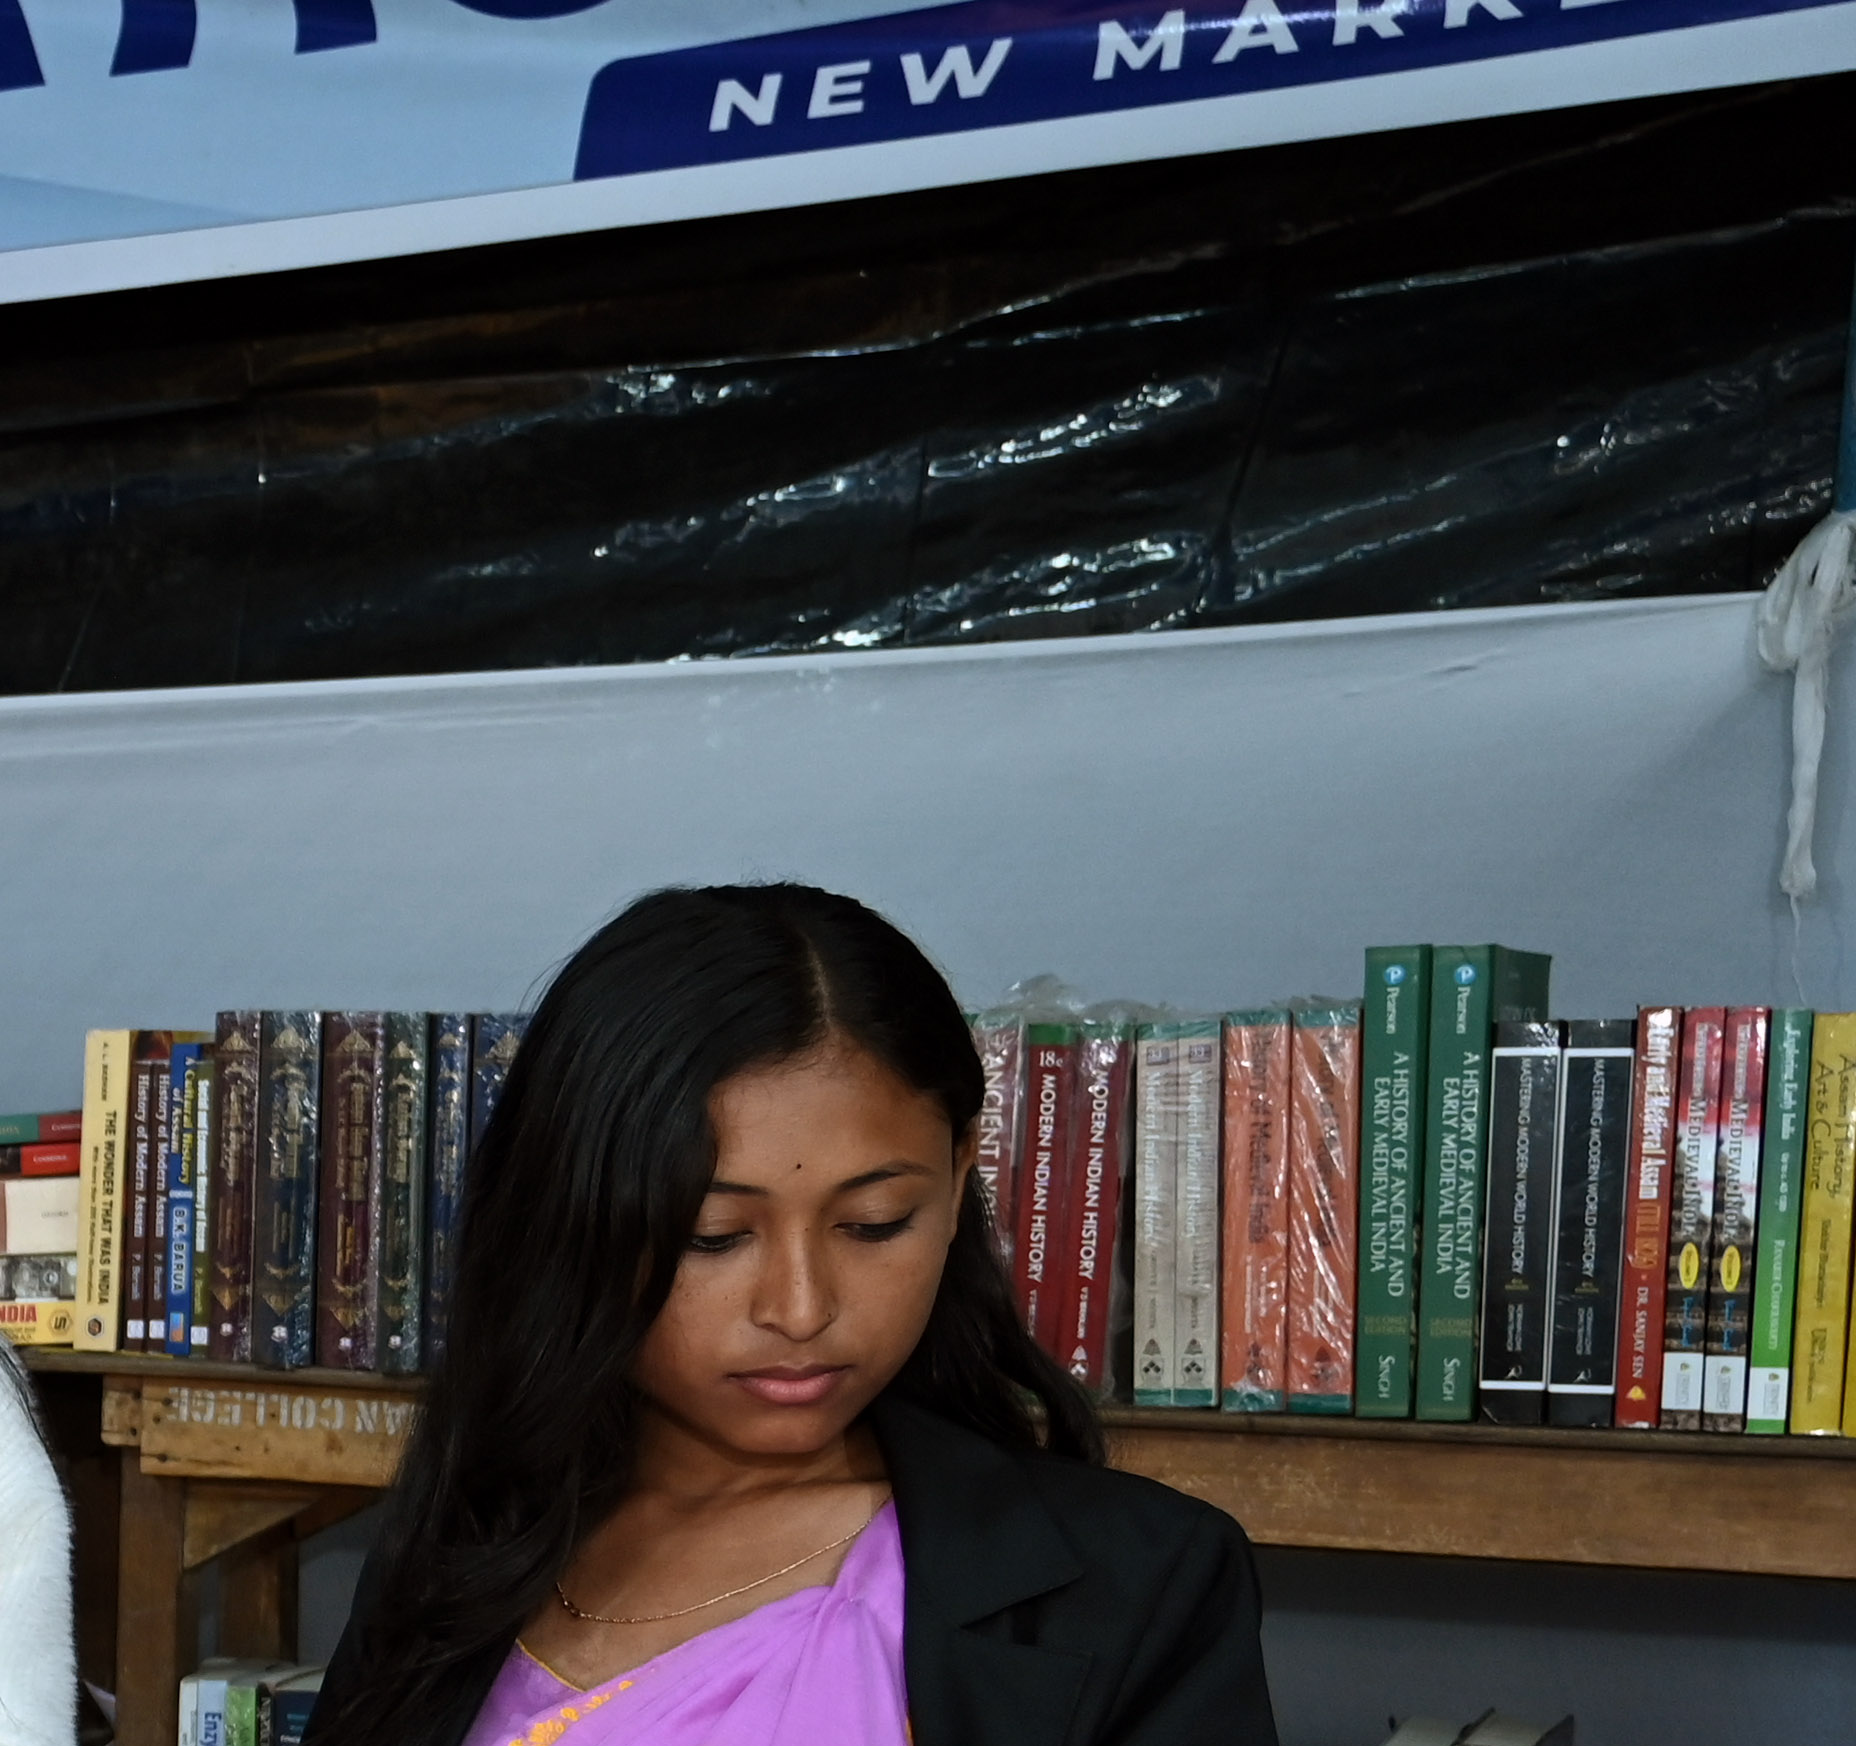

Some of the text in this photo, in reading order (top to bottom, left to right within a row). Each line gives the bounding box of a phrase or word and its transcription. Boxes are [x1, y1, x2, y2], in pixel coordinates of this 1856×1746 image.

[708, 39, 1013, 131] NEW
[1093, 0, 1596, 80] MAR
[1385, 988, 1398, 1033] Pearson
[1456, 987, 1469, 1033] Pearson
[135, 1075, 148, 1121] History
[155, 1075, 169, 1121] History
[979, 1052, 1002, 1159] ANCIENT
[135, 1143, 148, 1190] Modern
[155, 1142, 168, 1190] Modern
[1027, 1074, 1056, 1282] MODERN INDIAN HISTORY
[1078, 1070, 1109, 1279] MODERN INDIAN HISTORY
[1370, 1078, 1389, 1272] EARLY MEDIEVAL INDIA
[1387, 1052, 1408, 1296] A HISTORY OF ANCIENT AND
[1436, 1078, 1459, 1273] EARLY MEDIEVAL INDIA
[1510, 1058, 1532, 1274] MASTERING MODERN WORLD HISTORY
[98, 1111, 117, 1305] THE WONDER THAT WAS INDIA
[134, 1195, 146, 1238] Assam
[154, 1195, 166, 1237] Assam
[172, 1208, 187, 1291] B.K. BARUA
[166, 1385, 345, 1429] COLLEGE
[1376, 1355, 1393, 1398] SINGH
